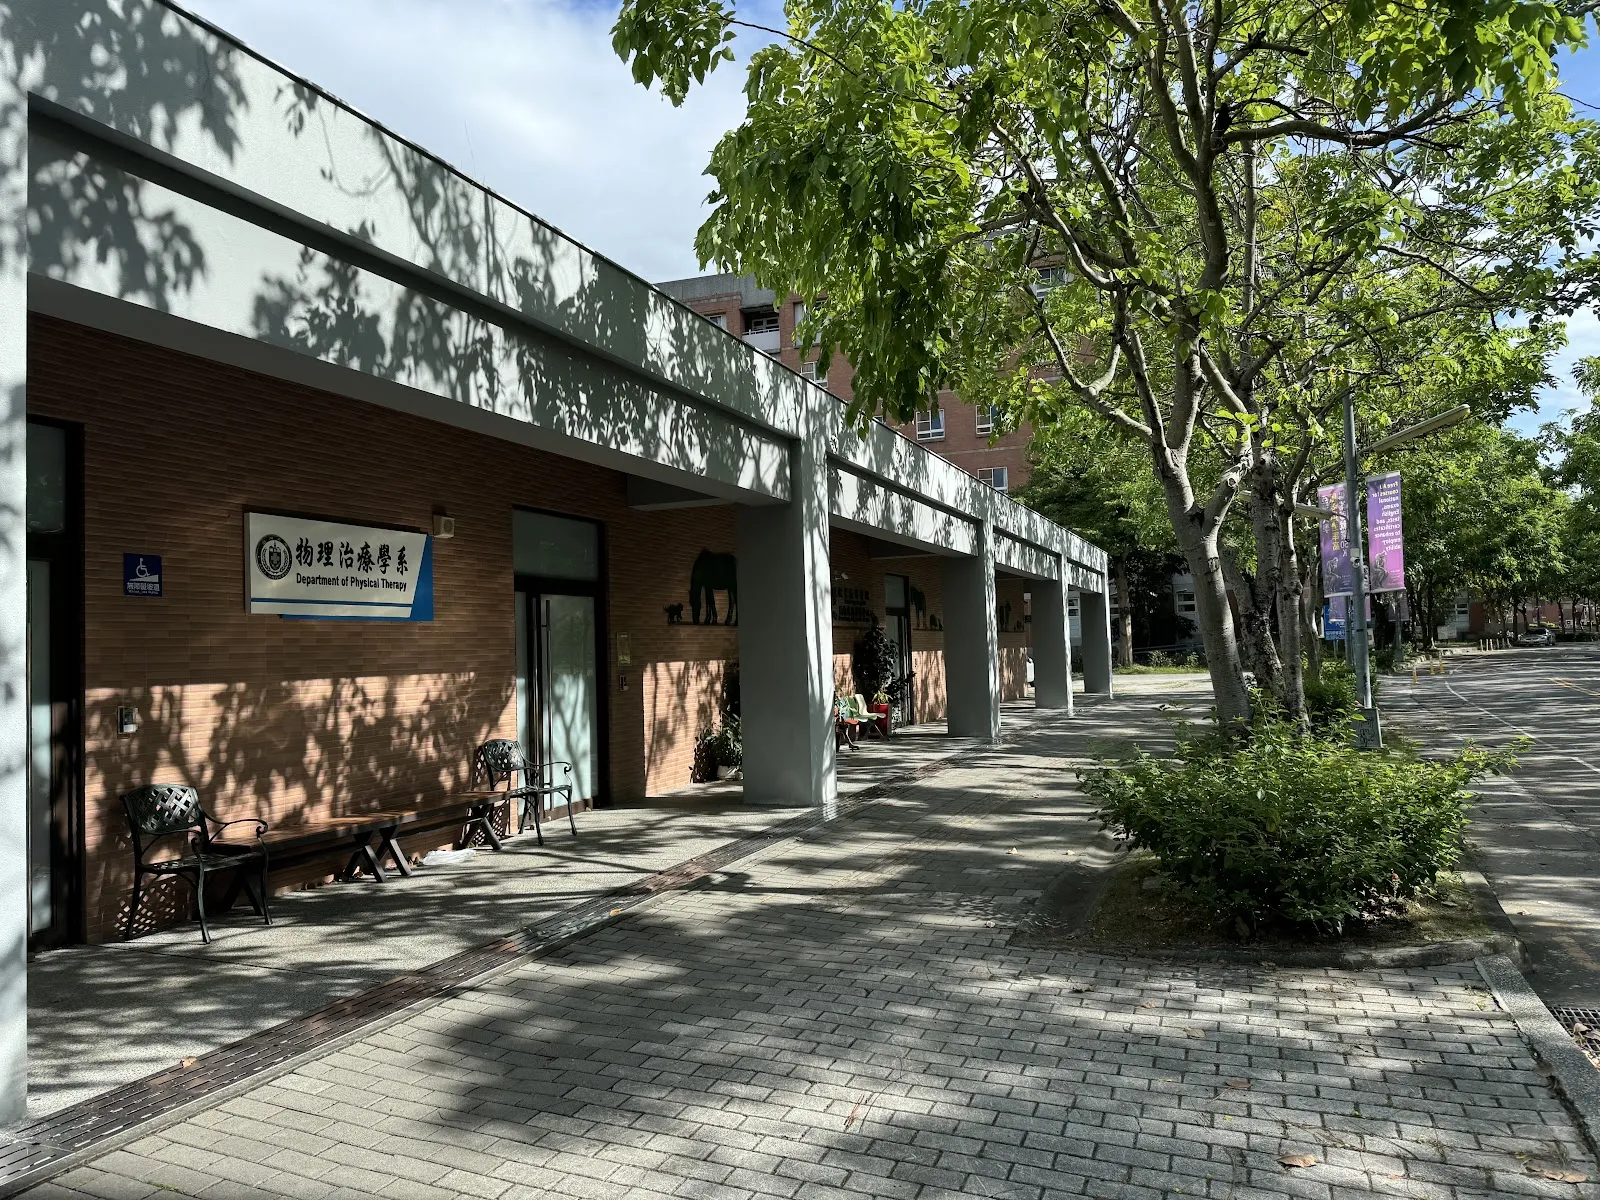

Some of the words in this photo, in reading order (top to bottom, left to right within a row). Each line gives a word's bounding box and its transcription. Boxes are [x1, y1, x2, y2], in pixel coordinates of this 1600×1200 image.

[296, 537, 409, 576] 物理治療學系
[296, 573, 340, 587] Department
[341, 576, 349, 587] of
[351, 578, 380, 590] Physical
[381, 579, 408, 592] Therapy
